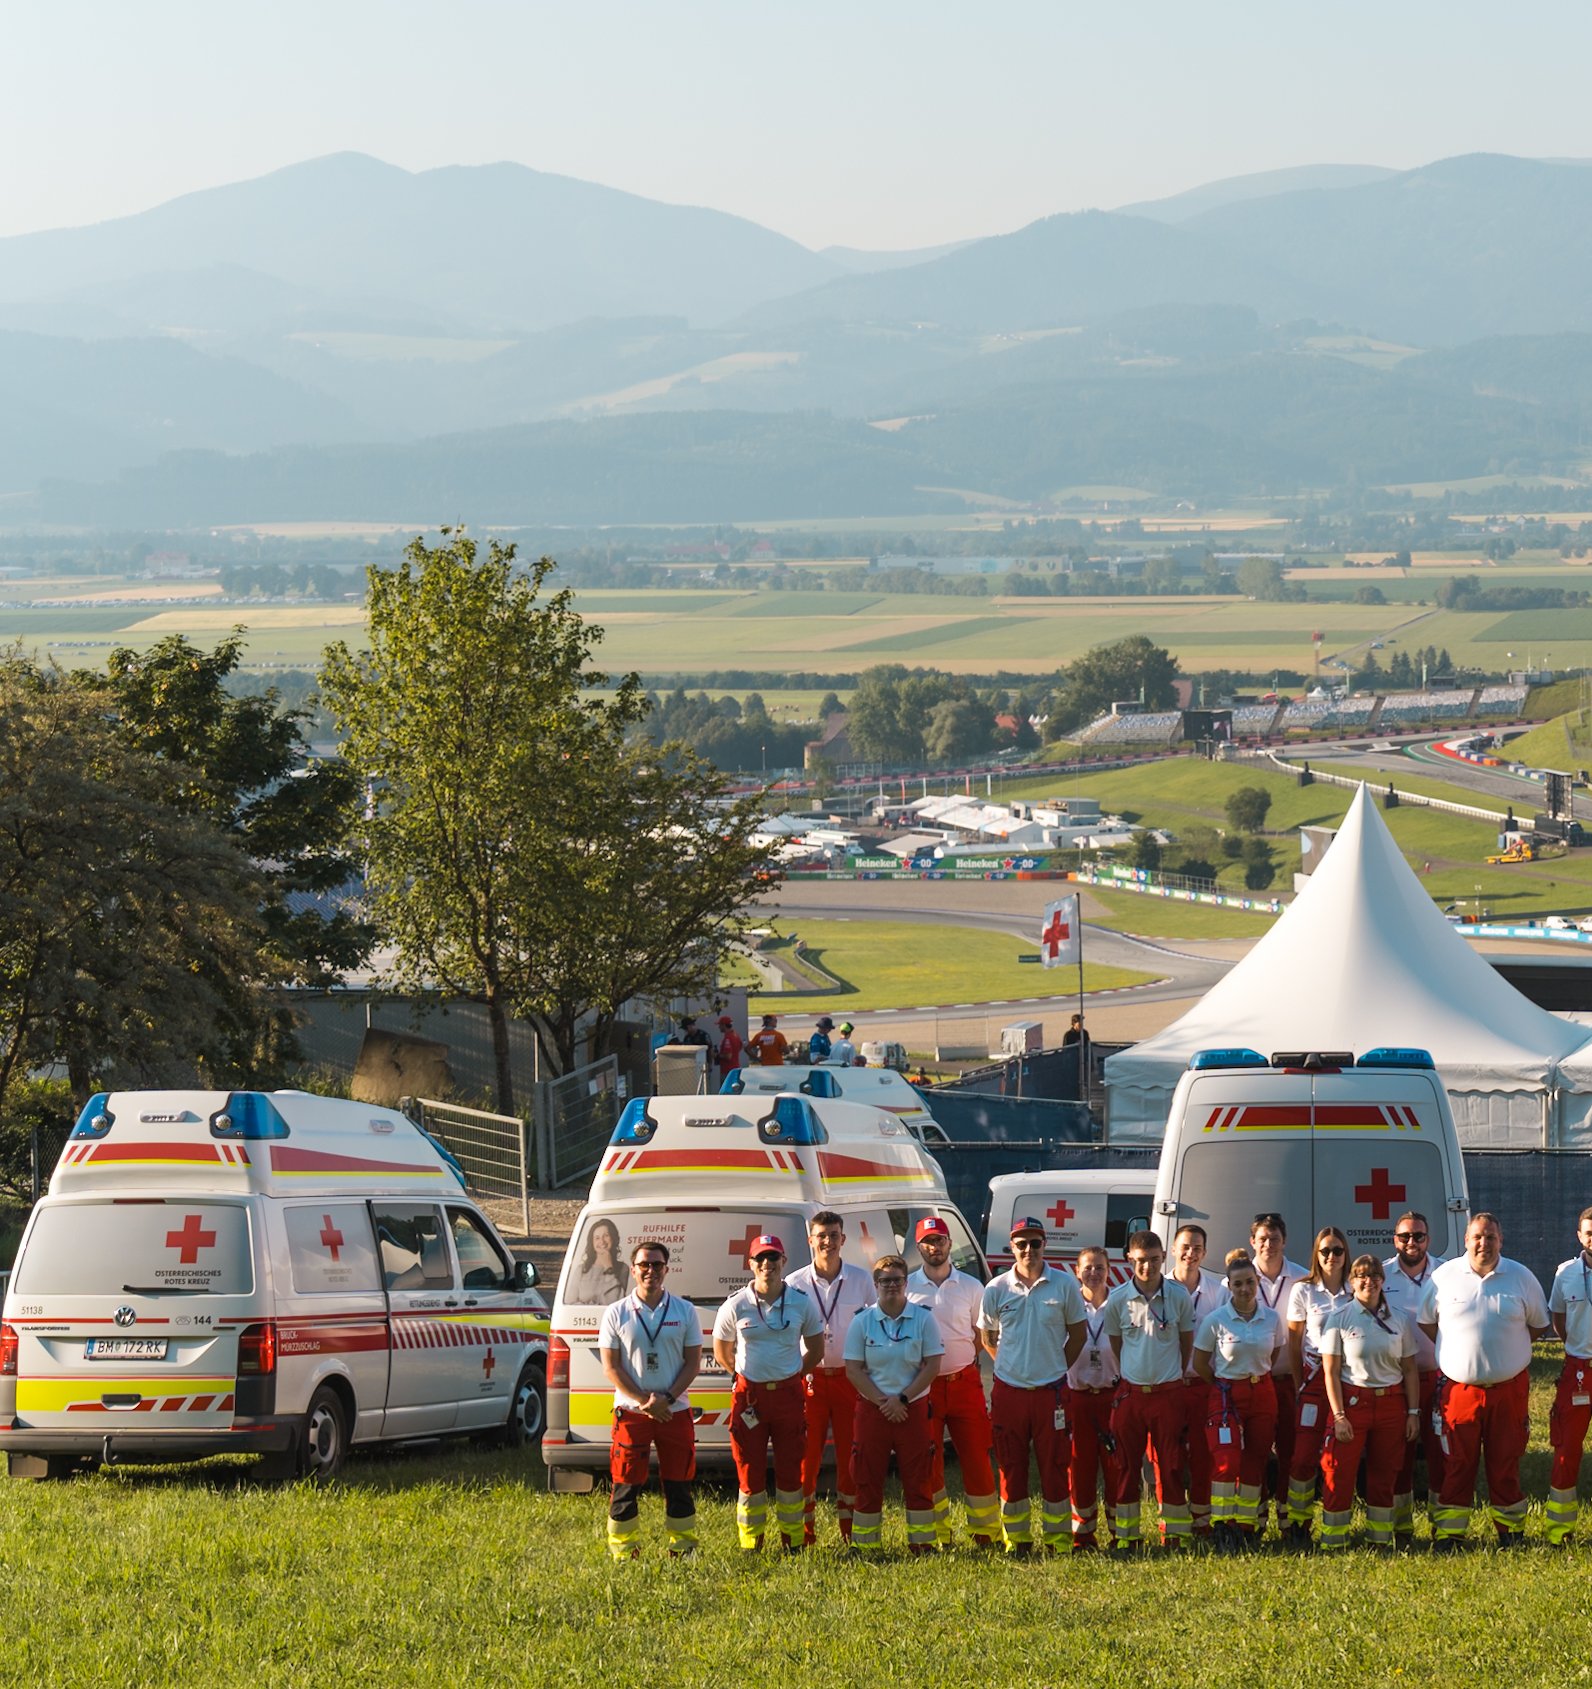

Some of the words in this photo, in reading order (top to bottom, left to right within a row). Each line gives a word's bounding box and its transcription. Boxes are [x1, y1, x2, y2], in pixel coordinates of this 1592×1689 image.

[855, 858, 897, 868] Heineken
[956, 858, 999, 868] Heineken
[643, 1224, 687, 1233] RUFHILFE
[627, 1235, 685, 1245] STEIERMARK
[155, 1269, 222, 1277] ÖSTERREICHISCHES
[21, 1306, 44, 1315] 51138
[193, 1315, 212, 1325] 144
[573, 1317, 598, 1326] 51143
[280, 1330, 298, 1340] BRUCK-
[97, 1340, 114, 1353] BM
[124, 1340, 144, 1353] 172
[146, 1340, 162, 1353] RK
